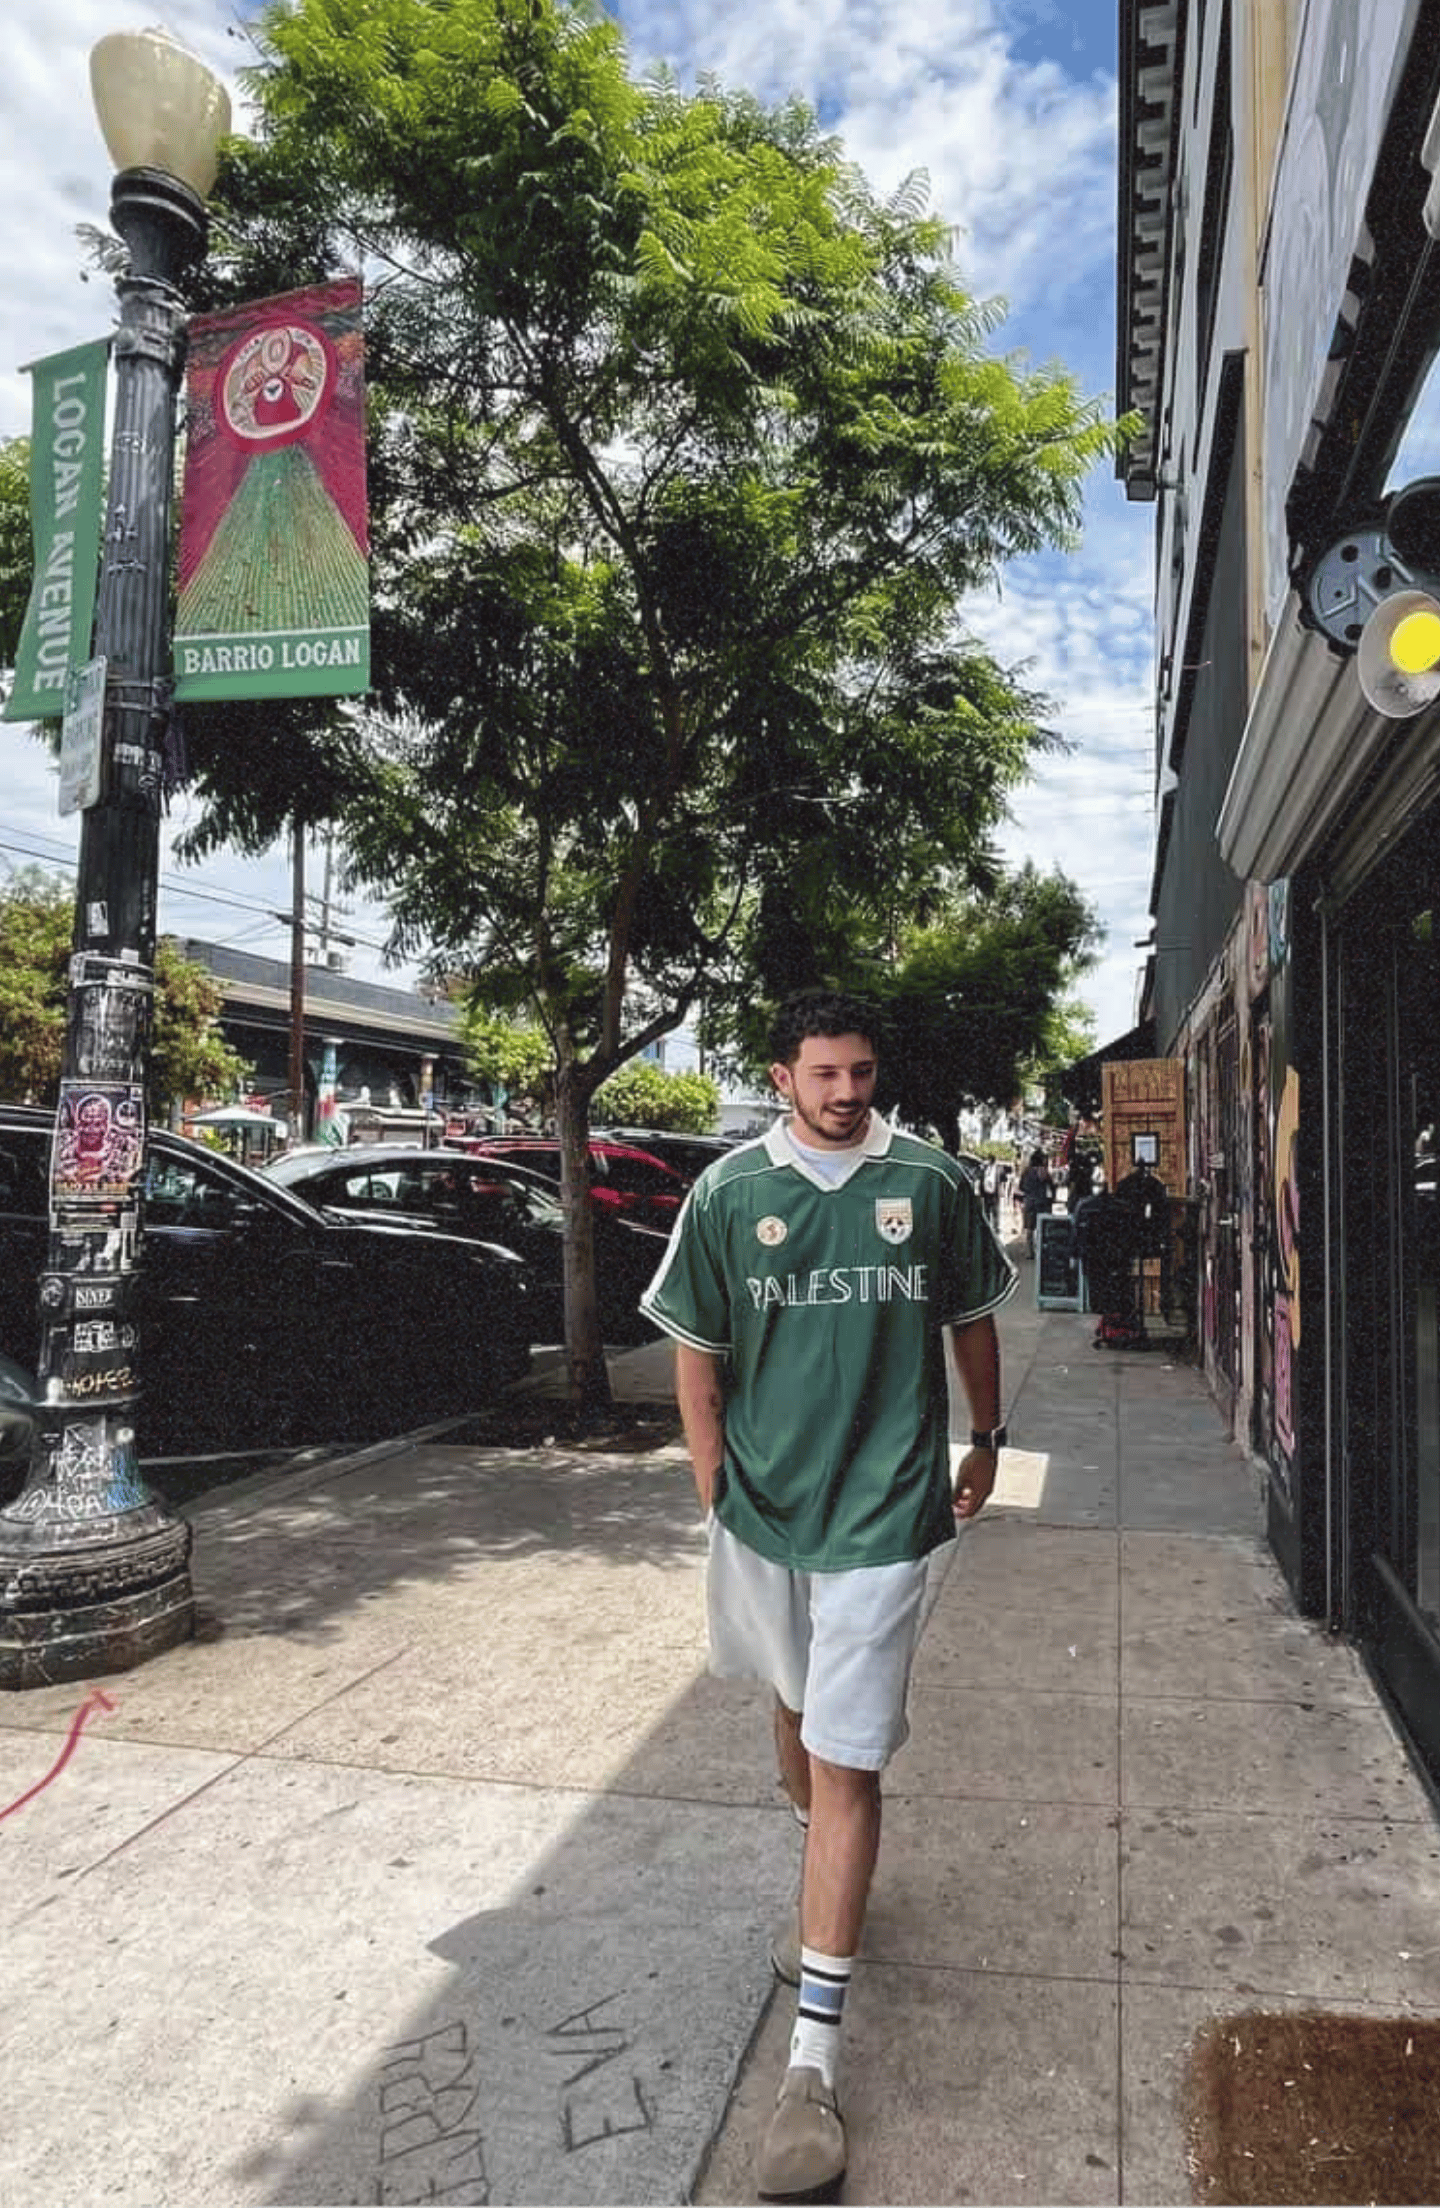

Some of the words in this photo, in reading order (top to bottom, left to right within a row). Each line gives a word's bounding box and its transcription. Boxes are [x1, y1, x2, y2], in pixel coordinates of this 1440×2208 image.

[52, 372, 87, 520] LOGAN
[32, 531, 75, 693] AVENUE
[184, 645, 274, 675] BARRIO
[281, 638, 361, 669] LOGAN
[746, 1264, 929, 1312] PALESTINE
[545, 1988, 653, 2153] EVA
